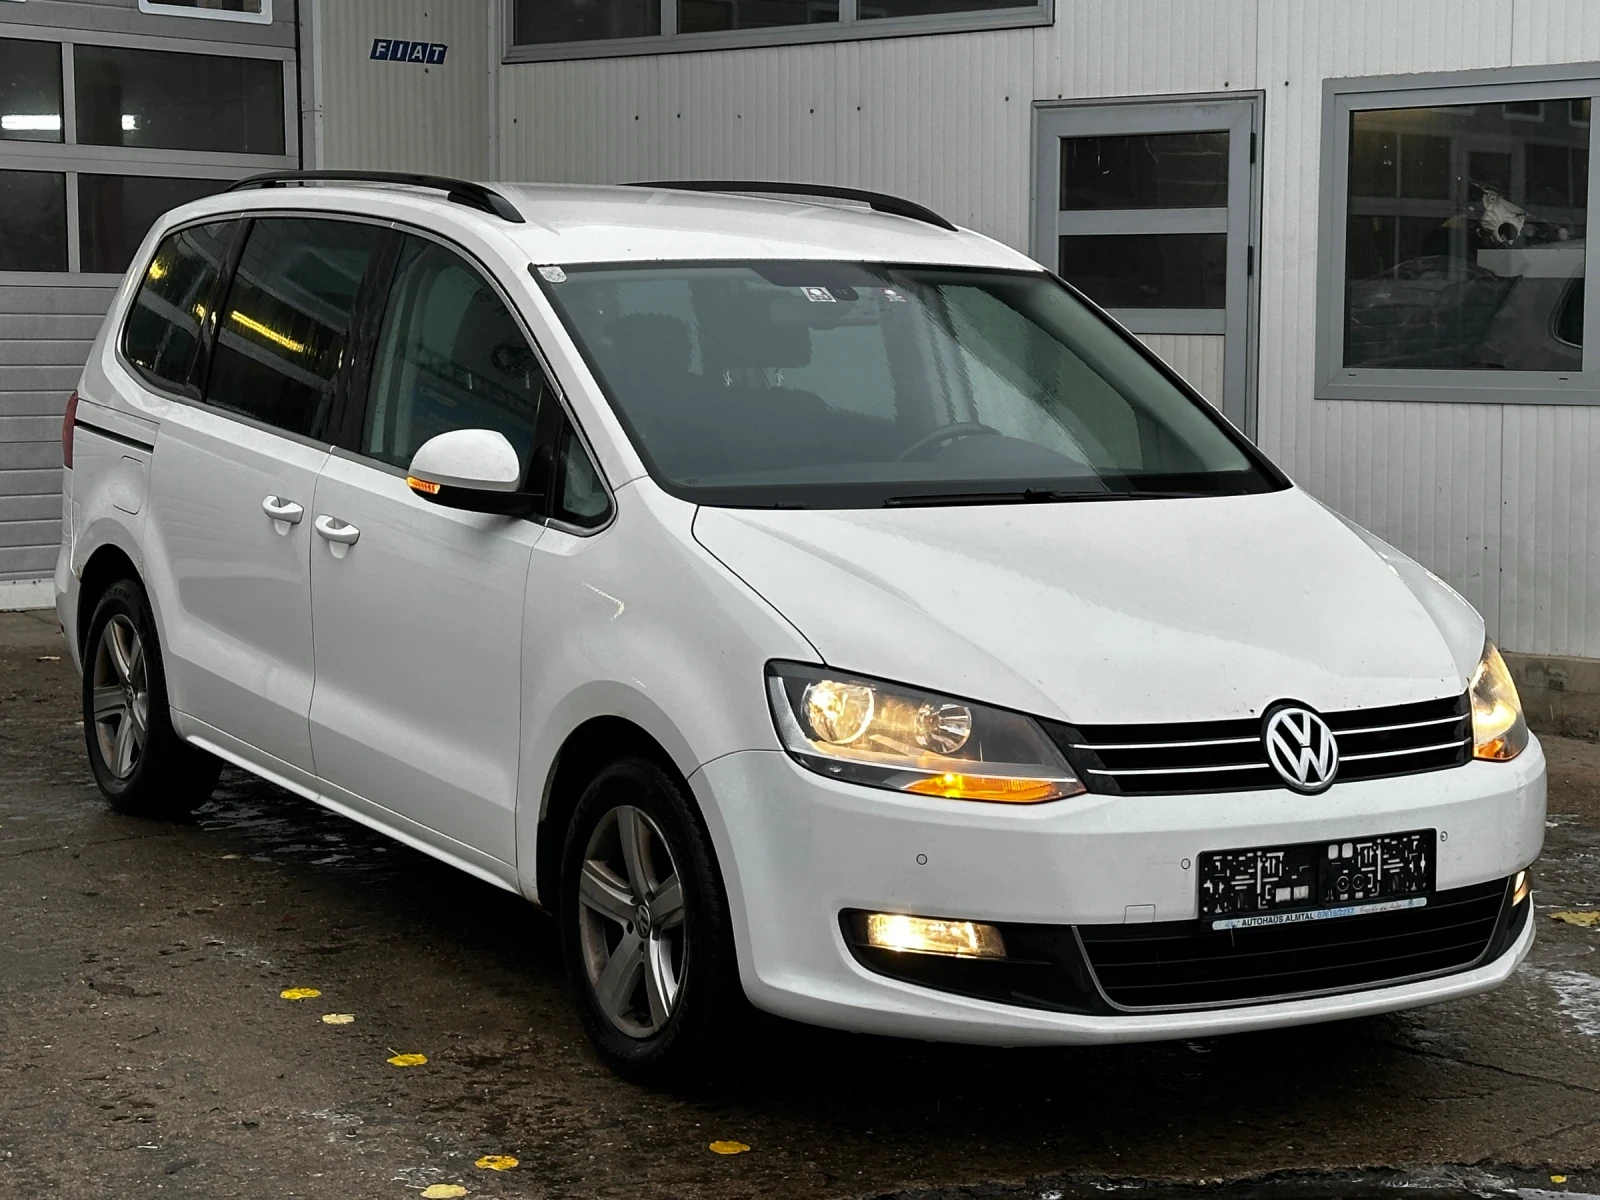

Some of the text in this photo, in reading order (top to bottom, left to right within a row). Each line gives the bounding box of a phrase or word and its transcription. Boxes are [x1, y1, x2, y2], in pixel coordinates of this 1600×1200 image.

[374, 42, 444, 61] FIAT
[1268, 708, 1335, 786] VW
[1241, 914, 1284, 927] AUTOHAUS
[1285, 912, 1315, 922] ALMTAL
